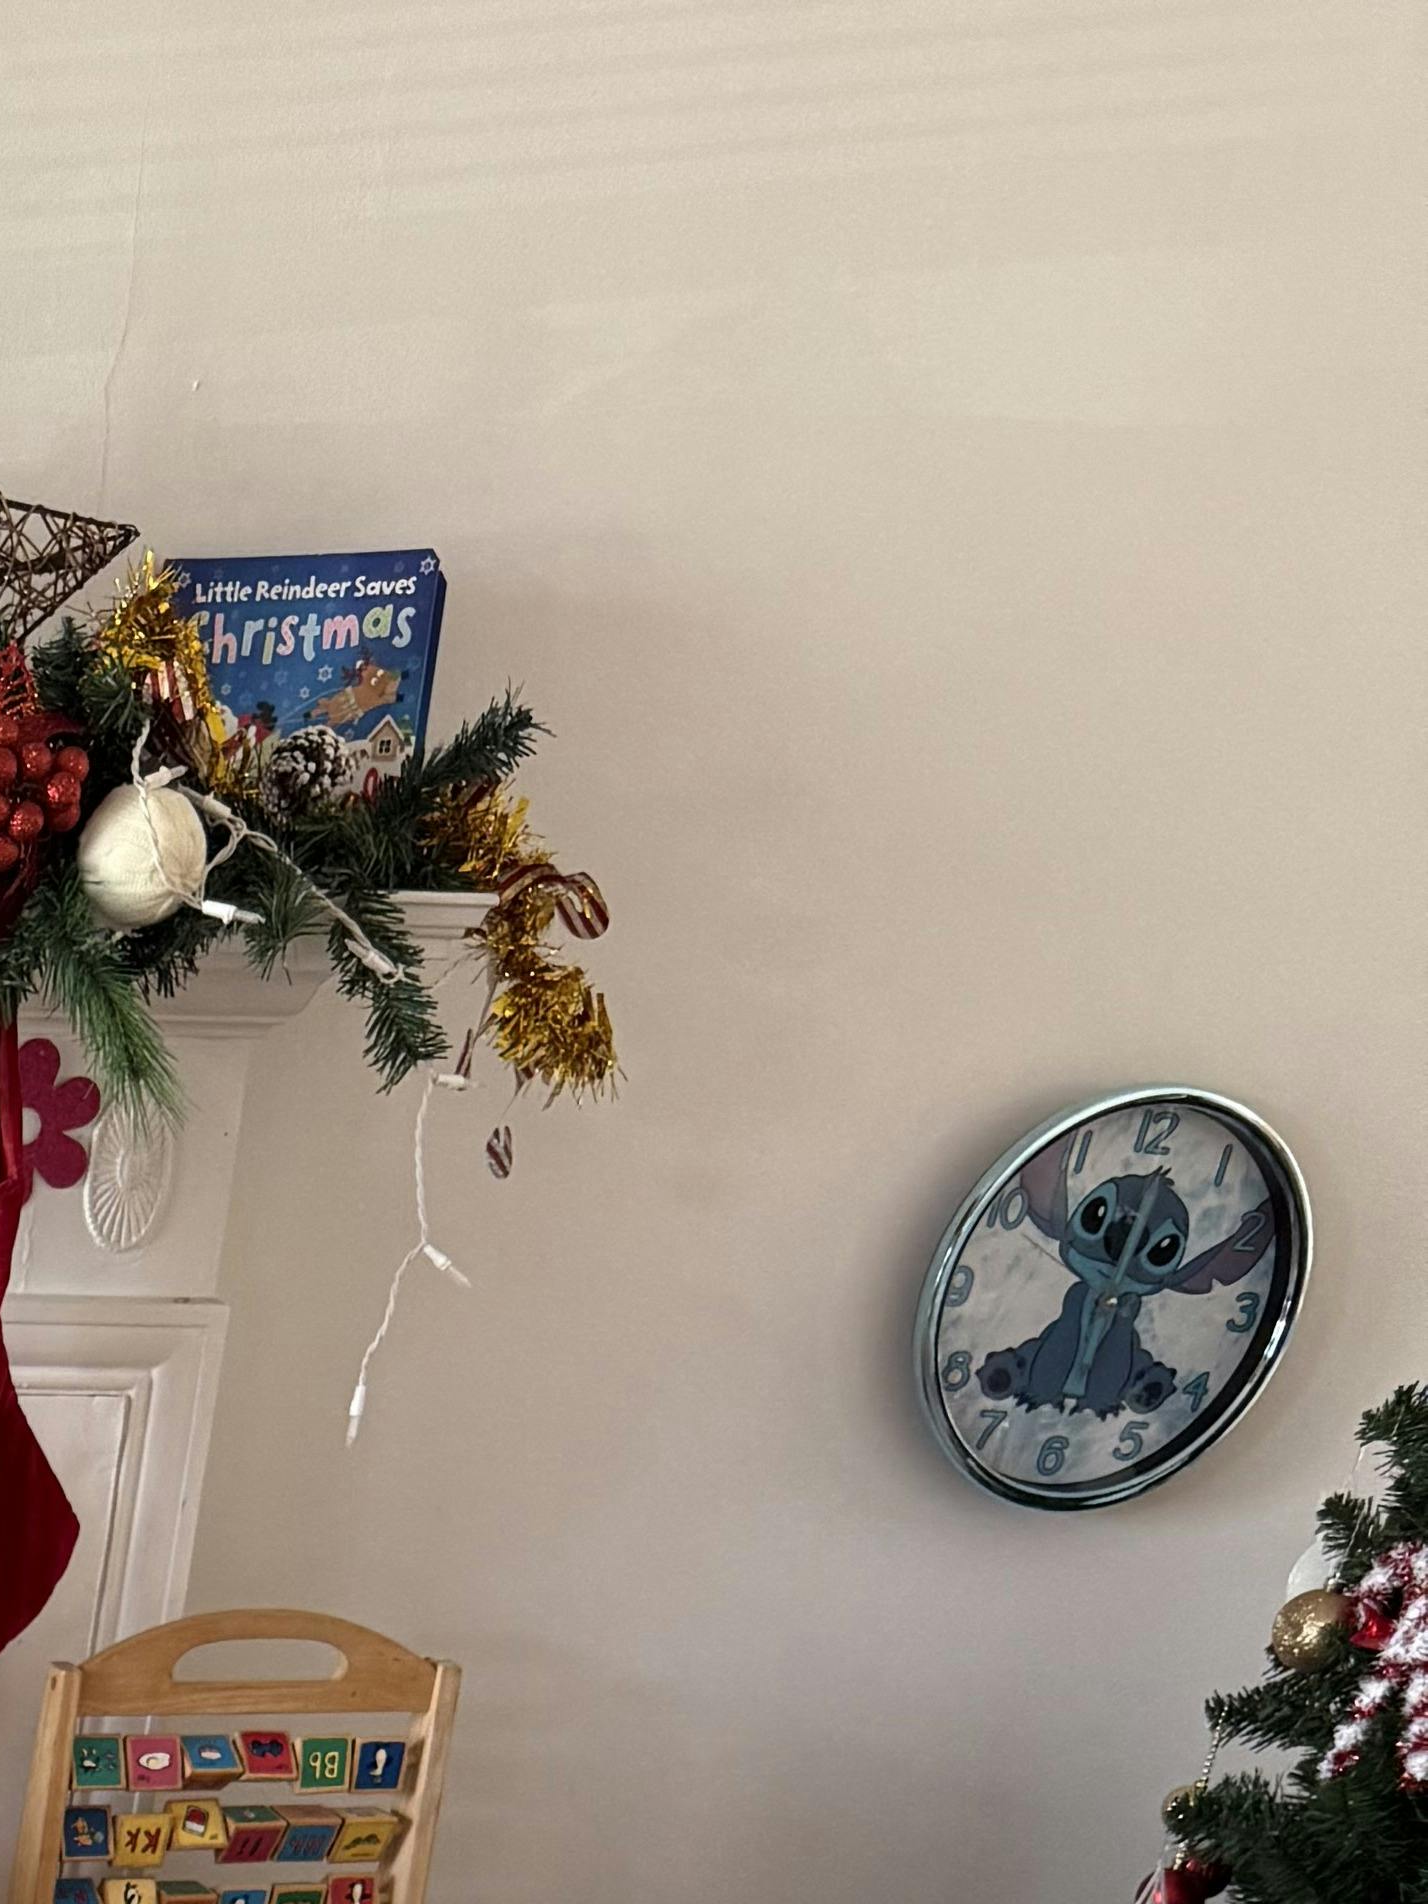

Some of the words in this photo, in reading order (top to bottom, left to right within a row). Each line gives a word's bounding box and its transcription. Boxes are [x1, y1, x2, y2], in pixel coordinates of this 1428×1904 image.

[194, 580, 253, 604] Little
[254, 575, 353, 602] Reindeer
[353, 575, 418, 598] Saves
[1133, 1108, 1181, 1156] 12
[1212, 1143, 1233, 1188] 1
[985, 1187, 1030, 1231] 10
[1231, 1212, 1267, 1252] 2
[944, 1266, 975, 1307] 9
[1225, 1291, 1259, 1333] 3
[942, 1350, 972, 1392] 8
[1182, 1371, 1212, 1413] 4
[975, 1409, 1007, 1450] 7
[1111, 1420, 1150, 1461] 5
[1035, 1435, 1070, 1476] 6
